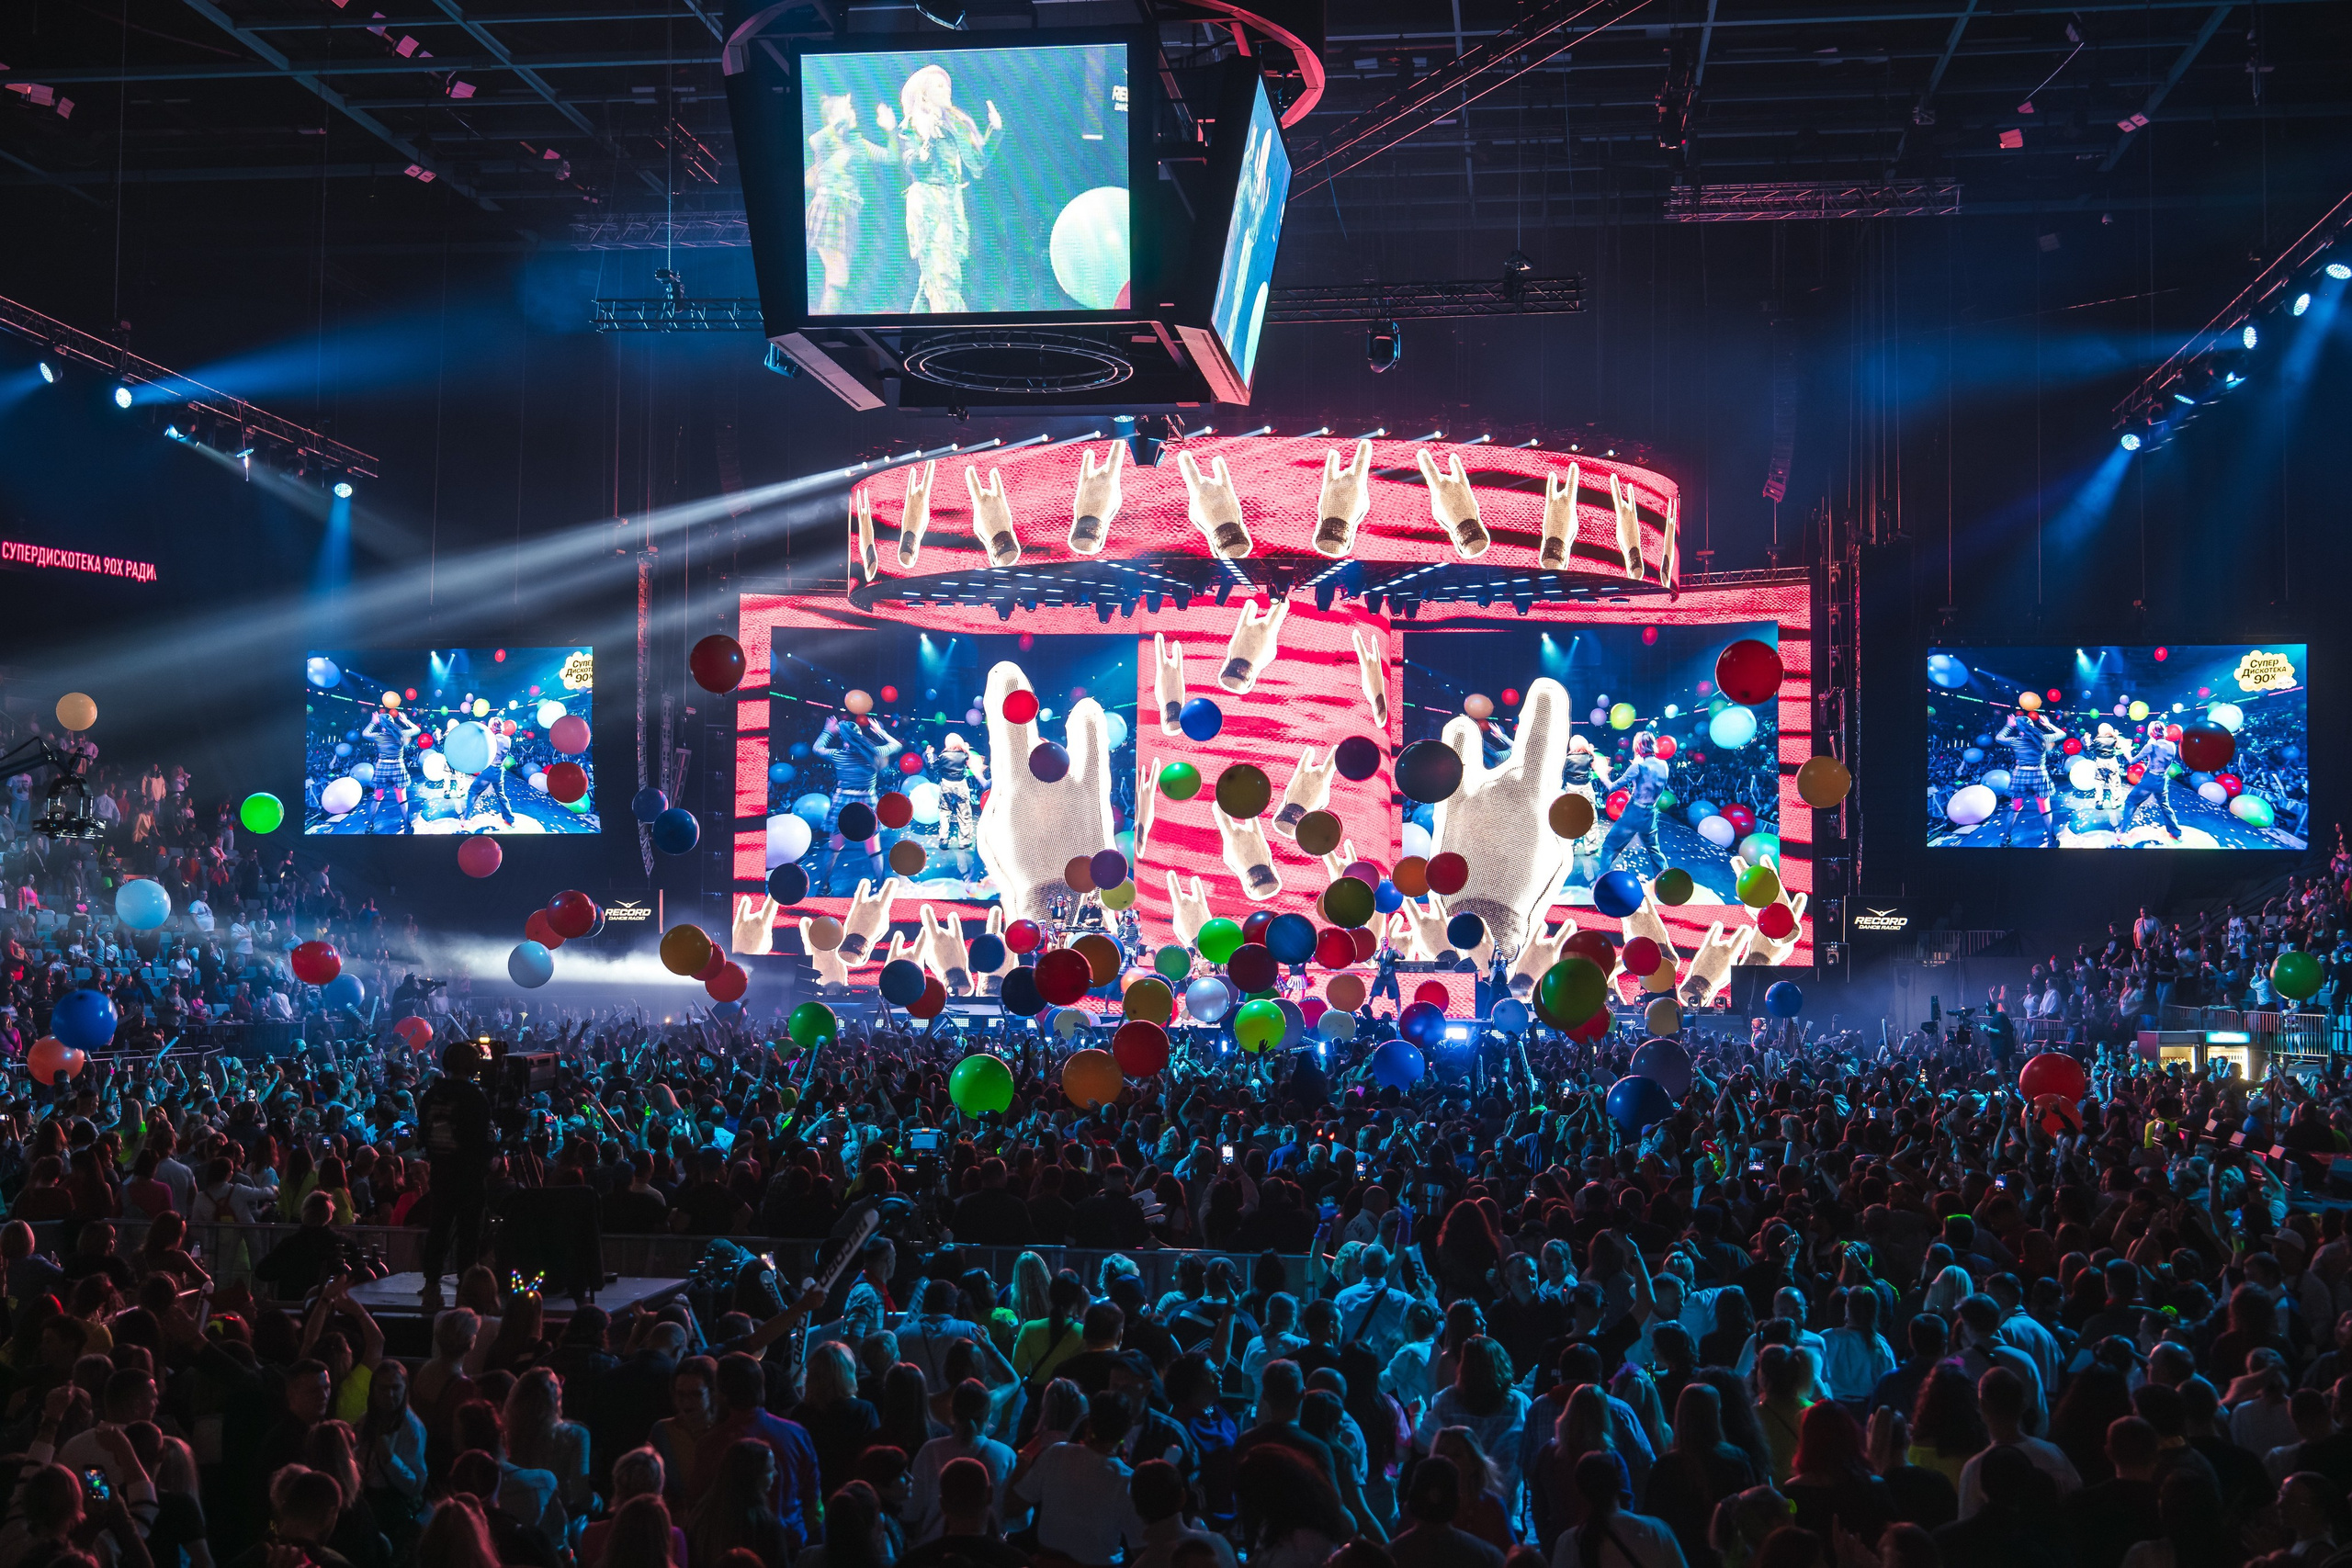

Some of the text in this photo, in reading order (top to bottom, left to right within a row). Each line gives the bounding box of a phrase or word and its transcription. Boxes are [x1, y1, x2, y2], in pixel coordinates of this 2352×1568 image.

[2, 540, 102, 574] СУПЕРДИСКОТЕКА
[125, 560, 157, 582] РАДИ
[605, 908, 651, 917] RECORD
[1854, 917, 1907, 925] RECORD
